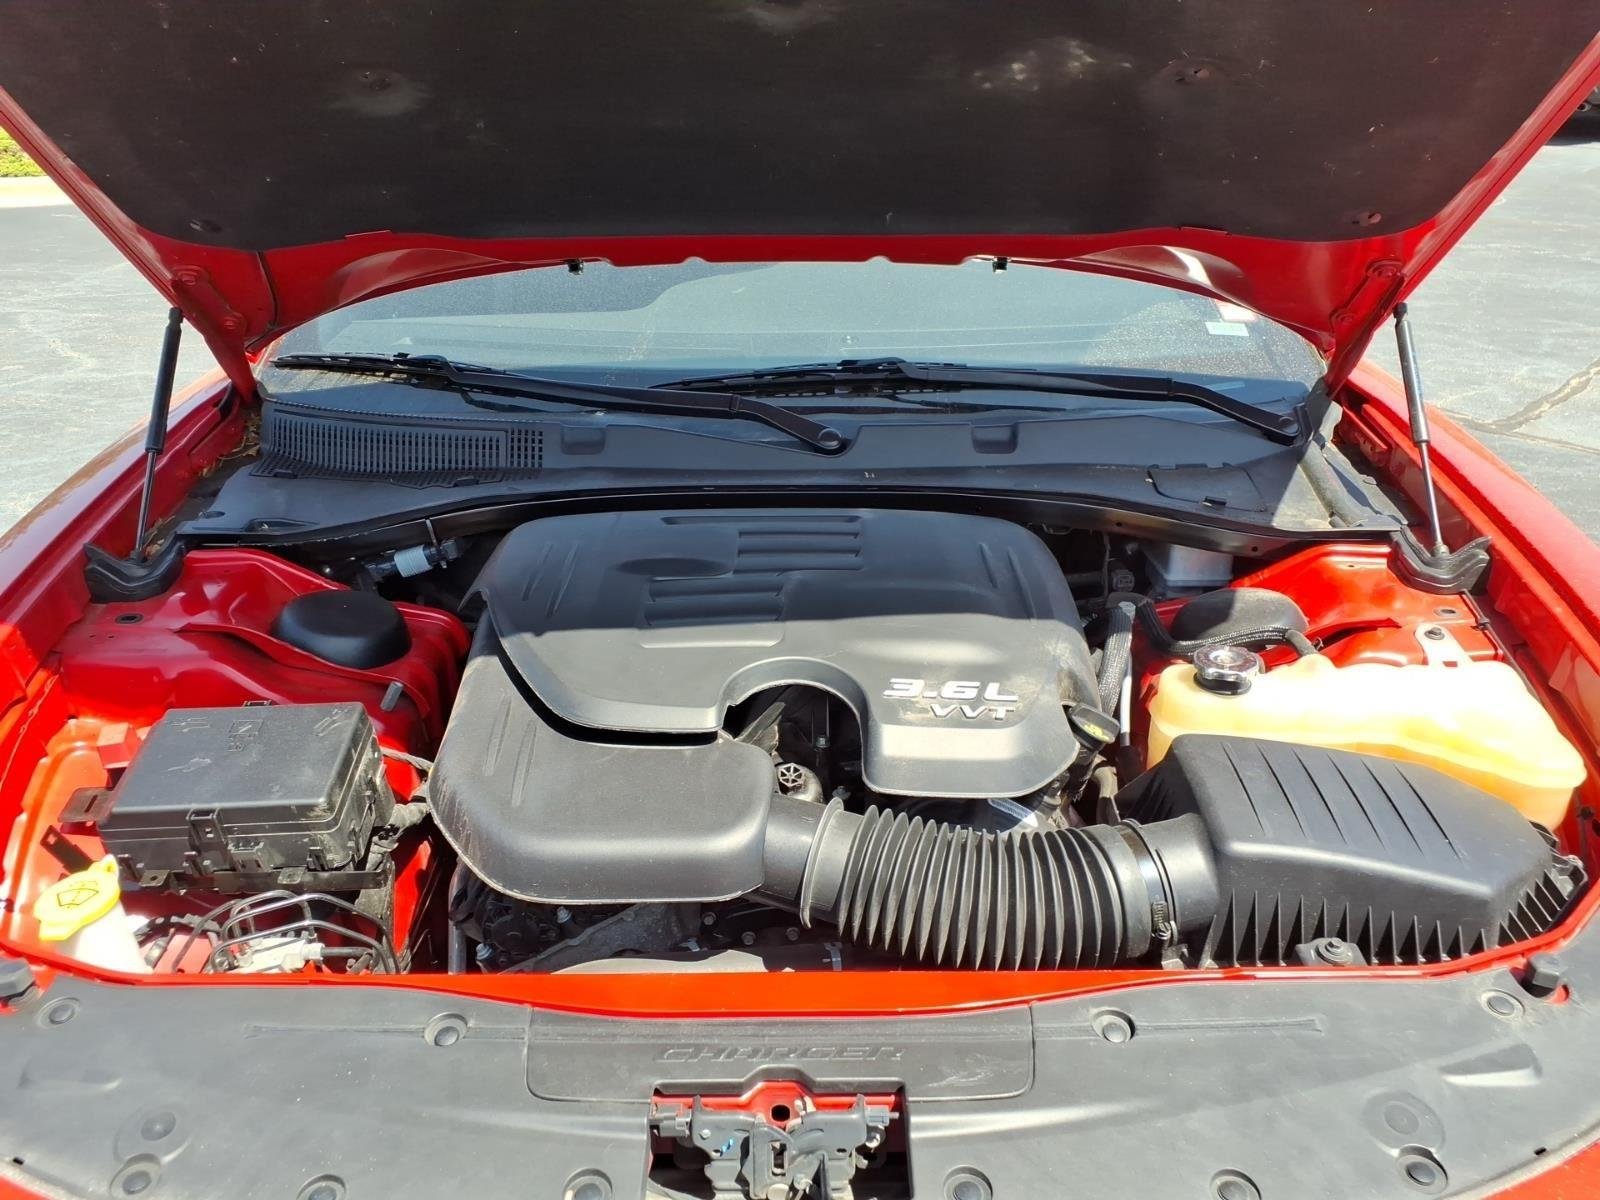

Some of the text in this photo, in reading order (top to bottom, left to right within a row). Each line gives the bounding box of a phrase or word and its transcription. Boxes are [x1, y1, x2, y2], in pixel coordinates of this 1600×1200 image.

[883, 678, 1018, 701] 3.6L
[930, 703, 1015, 720] VVT
[657, 1046, 905, 1063] CHARGER
